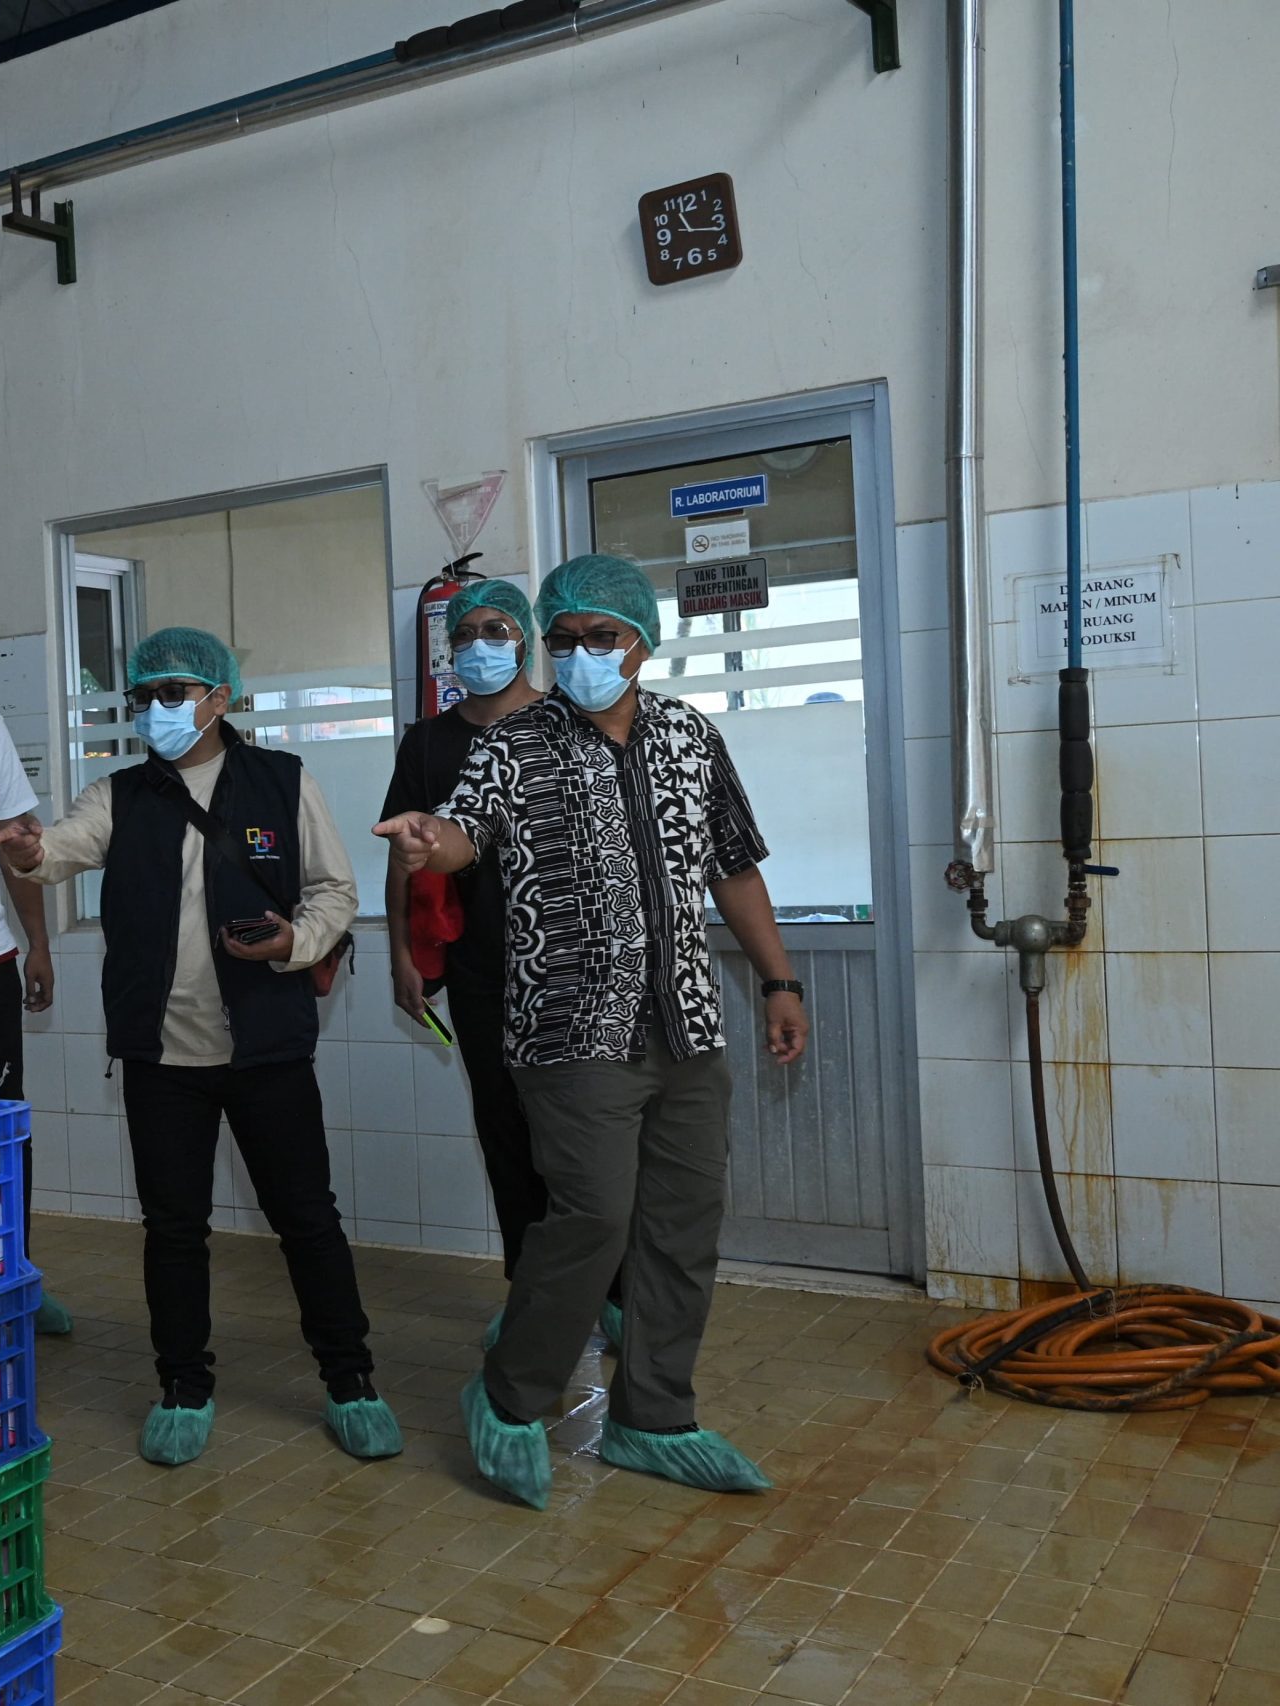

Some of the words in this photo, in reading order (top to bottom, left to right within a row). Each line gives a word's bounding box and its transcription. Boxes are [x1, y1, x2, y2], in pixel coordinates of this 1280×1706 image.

[677, 193, 697, 213] 12
[701, 190, 707, 201] 1
[664, 198, 675, 212] 11
[713, 199, 722, 211] 2
[654, 214, 668, 227] 10
[711, 214, 726, 231] 3
[656, 228, 672, 246] 9
[717, 233, 728, 245] 4
[660, 249, 670, 261] 8
[672, 257, 683, 270] 7
[687, 248, 702, 265] 6
[707, 249, 717, 261] 5
[675, 496, 684, 508] R.
[686, 485, 761, 506] LABORATORIUM
[694, 568, 716, 582] YANG
[721, 564, 748, 579] TIDAK
[685, 577, 759, 598] BERKEPENTINGAN
[1060, 578, 1134, 595] DARANG
[683, 597, 728, 614] DILARANG
[730, 592, 763, 607] MASUK
[1040, 599, 1092, 614] MAKN
[1104, 592, 1156, 607] MINUM
[1083, 613, 1134, 628] RUANG
